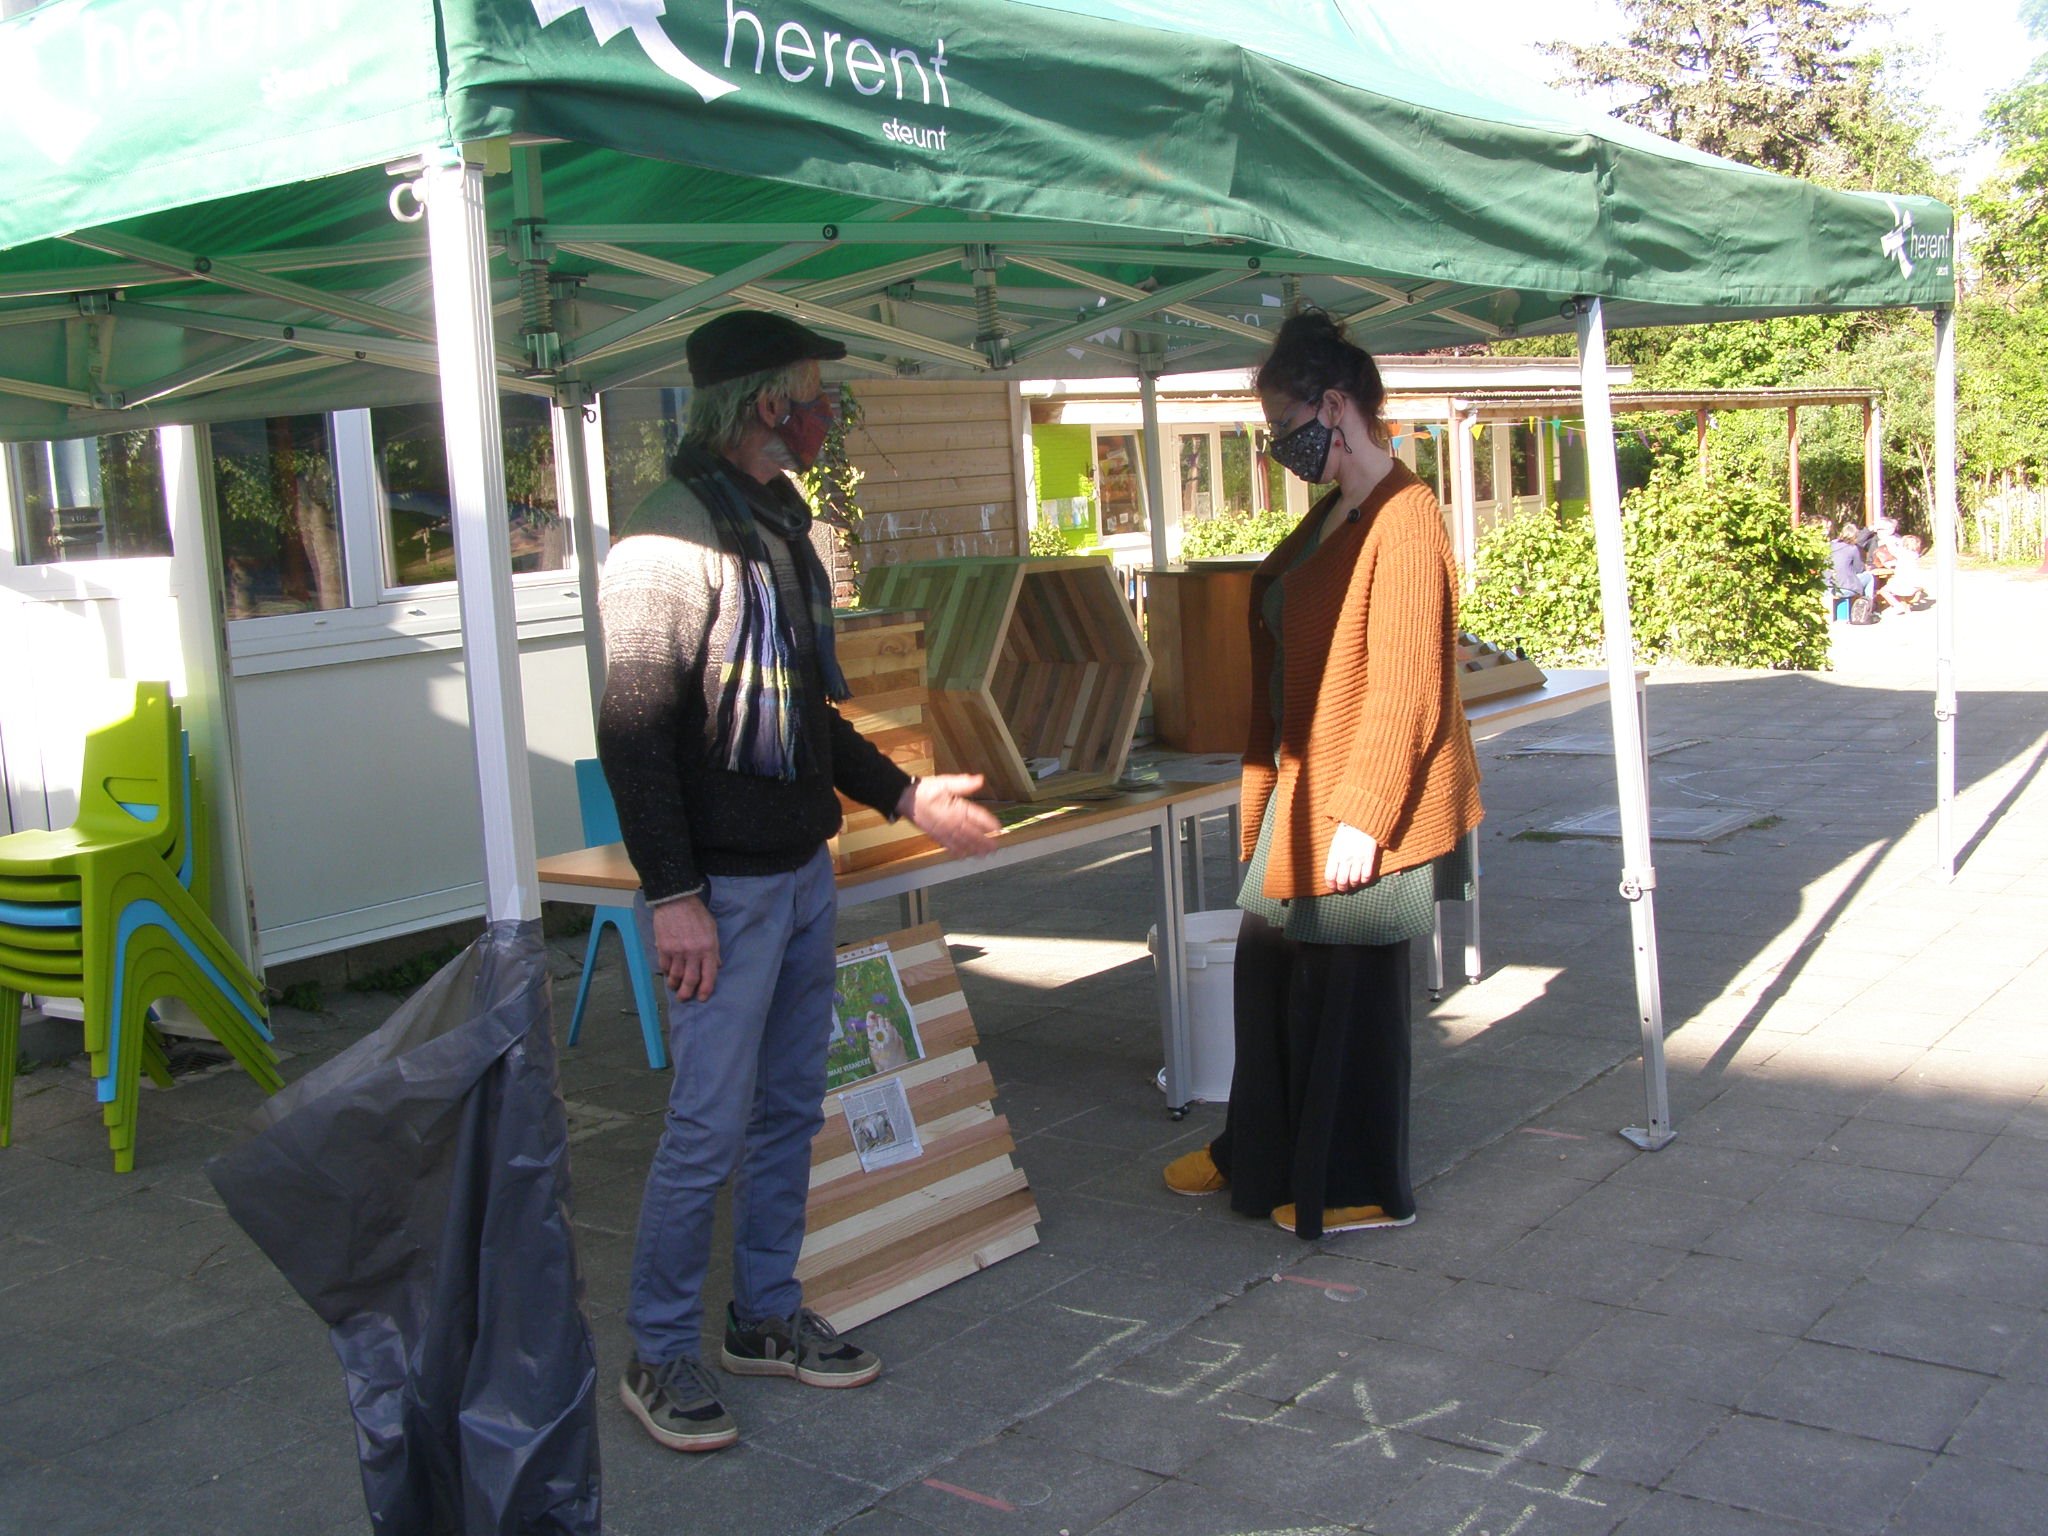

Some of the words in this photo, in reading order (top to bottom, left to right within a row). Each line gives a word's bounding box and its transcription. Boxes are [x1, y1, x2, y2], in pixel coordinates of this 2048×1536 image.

[724, 0, 950, 108] herent
[882, 118, 947, 151] steunt
[1910, 227, 1950, 259] herent
